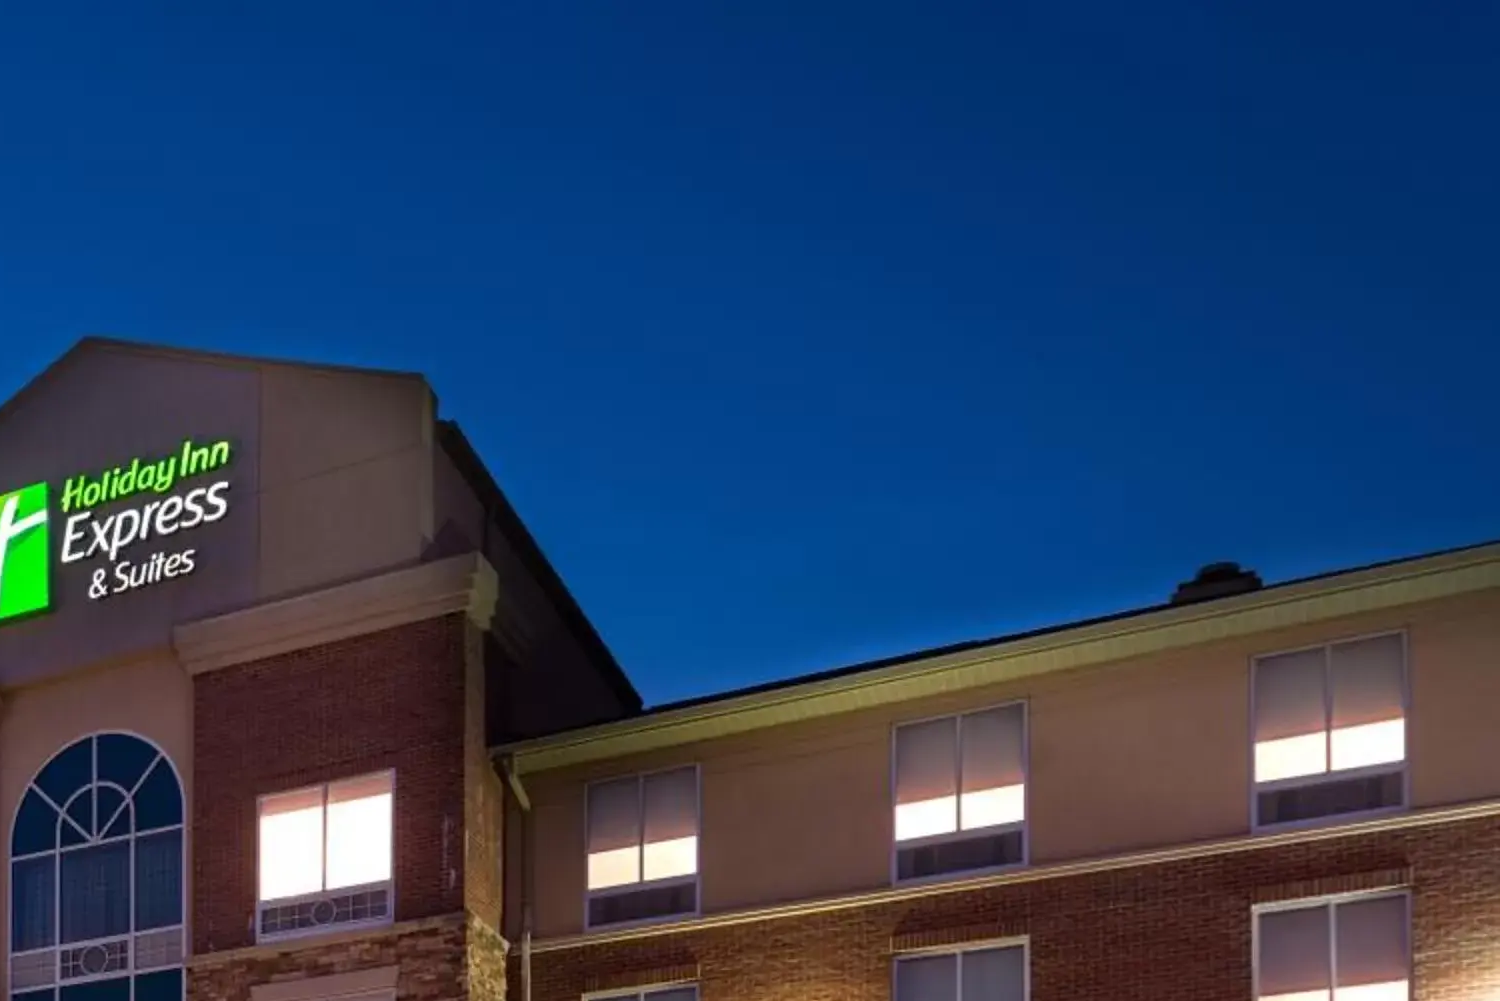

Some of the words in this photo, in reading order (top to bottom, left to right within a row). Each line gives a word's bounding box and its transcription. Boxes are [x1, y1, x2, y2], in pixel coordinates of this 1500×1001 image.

[62, 459, 177, 512] Holiday
[181, 440, 230, 477] Inn
[61, 481, 230, 563] Express
[88, 569, 108, 599] &
[113, 549, 196, 593] Suites
